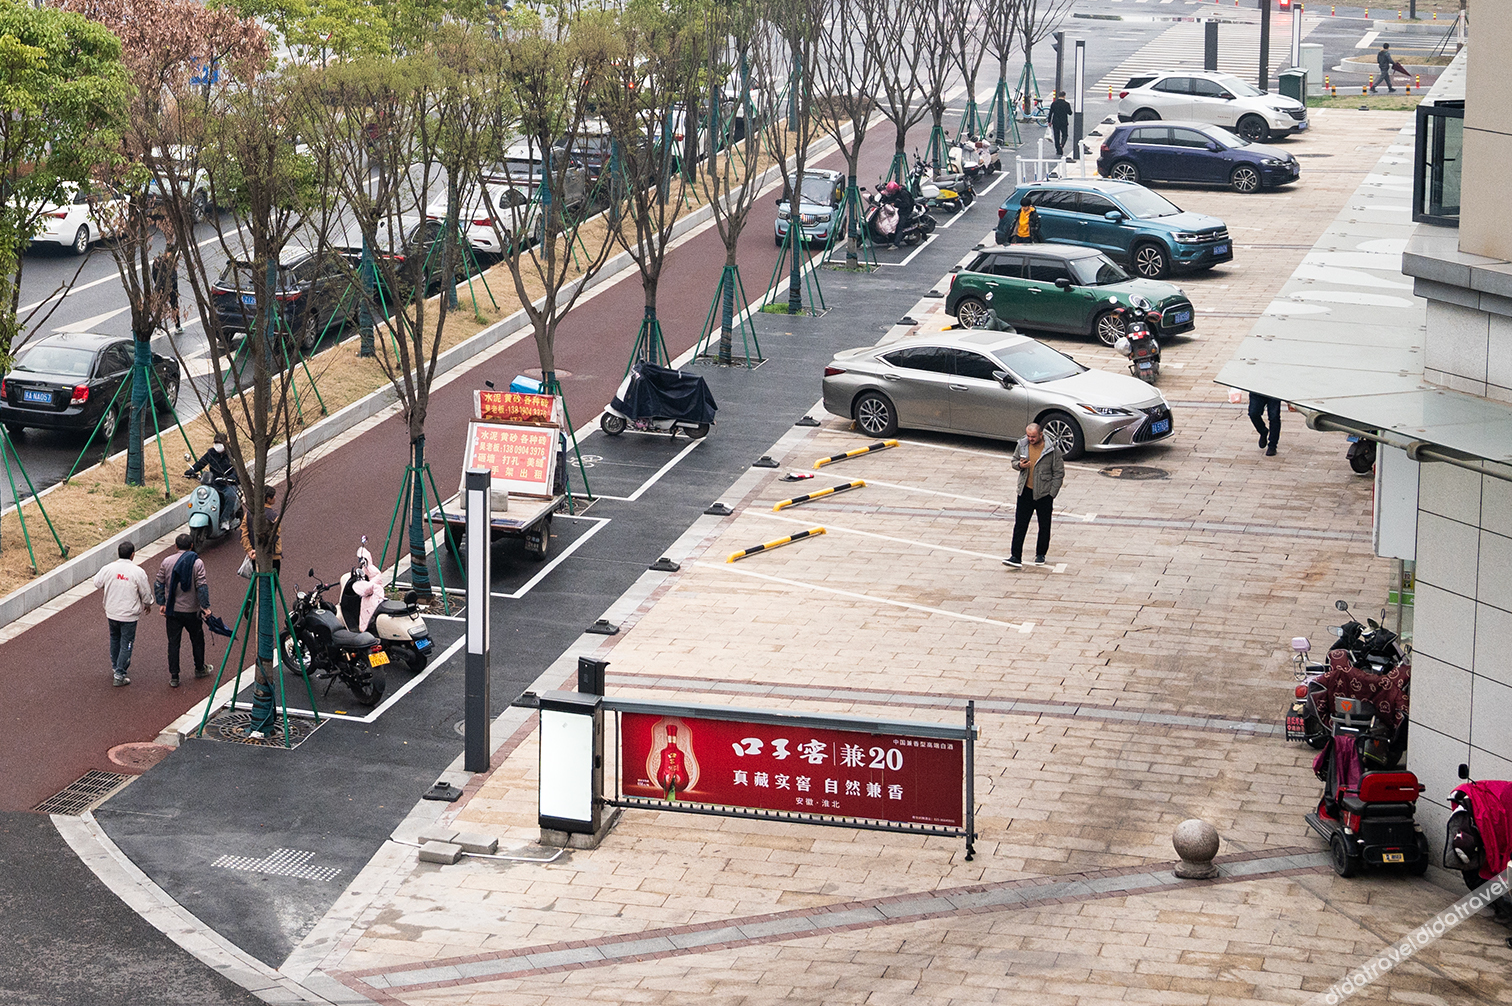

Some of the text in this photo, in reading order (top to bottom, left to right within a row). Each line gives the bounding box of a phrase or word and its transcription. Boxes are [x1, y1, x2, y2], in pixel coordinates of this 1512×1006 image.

[484, 393, 501, 403] 水泥
[504, 393, 521, 404] 黄砂
[481, 431, 497, 441] 水泥
[500, 432, 518, 442] 黄砂
[514, 445, 529, 454] 0904
[530, 447, 545, 456] 3976
[502, 455, 520, 466] 打孔
[731, 737, 904, 771] 口子窖 兼20
[732, 769, 904, 801] 真藏实窖 自然兼香
